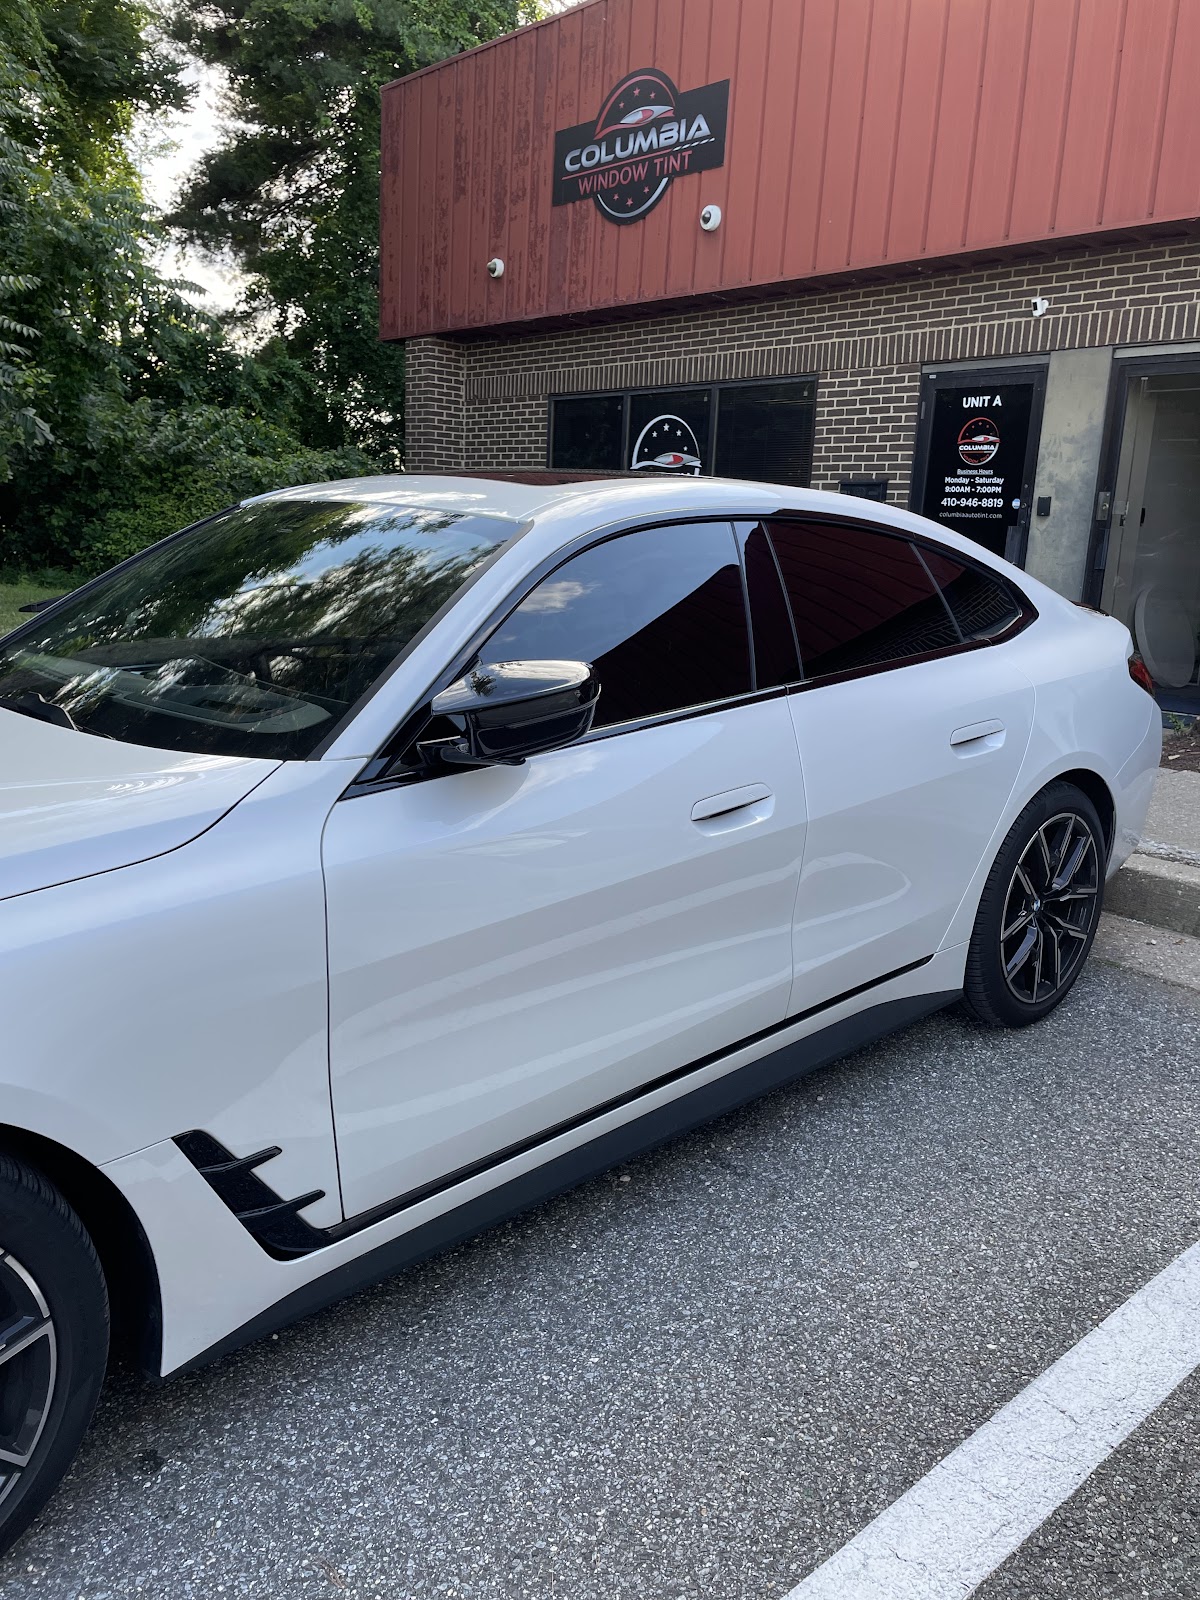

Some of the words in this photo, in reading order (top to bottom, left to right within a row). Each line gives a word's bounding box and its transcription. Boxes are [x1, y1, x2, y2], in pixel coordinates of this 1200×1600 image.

[565, 113, 711, 172] COLUMBIA
[578, 161, 649, 195] WINDOW
[654, 151, 692, 176] TINT
[962, 396, 990, 408] UNIT
[992, 395, 1002, 406] A
[941, 498, 1003, 507] 410-946-8819
